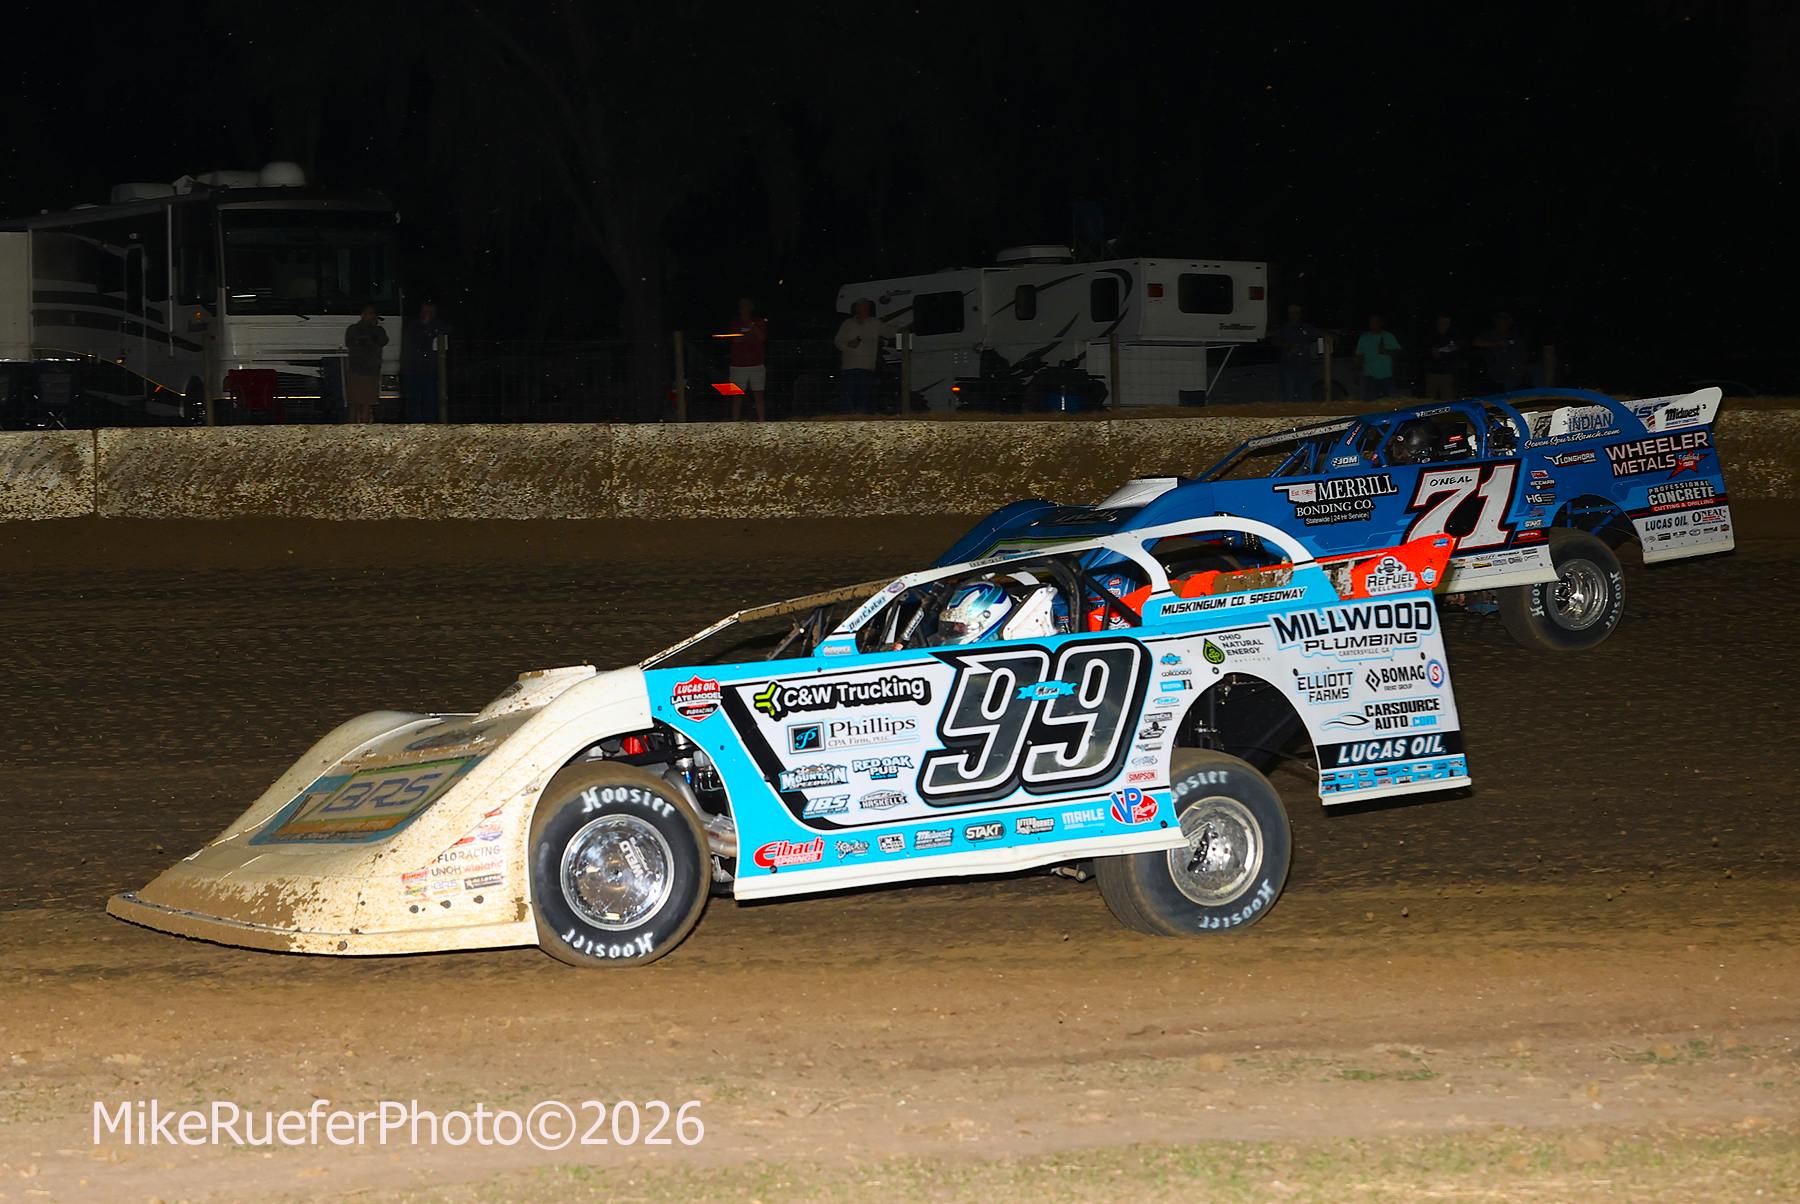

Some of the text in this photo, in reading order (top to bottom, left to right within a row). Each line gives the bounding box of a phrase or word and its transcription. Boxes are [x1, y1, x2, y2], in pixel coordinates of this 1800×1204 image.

[1568, 412, 1614, 431] INDIAN
[1665, 405, 1700, 421] Midwest
[1605, 432, 1708, 461] WHEELER
[1560, 452, 1595, 464] LONGHORN
[1613, 454, 1676, 476] METALS
[1318, 475, 1397, 501] MERRILL
[1429, 475, 1472, 487] O'NEAL
[1648, 480, 1709, 494] PROFESSIONAL
[1525, 493, 1543, 504] HG
[1648, 487, 1715, 506] CONCRETE
[1654, 503, 1680, 512] CUTTING
[1688, 499, 1714, 507] DRILLING
[1296, 499, 1374, 517] BONDING CO.
[1406, 464, 1516, 549] 71
[1645, 517, 1672, 531] LUCAS
[1675, 516, 1688, 527] OIL
[1370, 583, 1413, 593] WELLNESS
[1161, 588, 1306, 616] MUSKINGUM CO. SPEEDWAY
[1605, 571, 1623, 629] Hoosier
[1273, 601, 1432, 644] MILLWOOD
[1218, 633, 1241, 641] OHIO
[1222, 640, 1264, 649] NATURAL
[1304, 632, 1418, 651] PLUMBING
[1226, 647, 1261, 656] ENERGY
[1298, 671, 1354, 691] ELLIOTT
[1382, 665, 1426, 684] BOMAG
[677, 682, 716, 695] LUCAS OIL
[783, 678, 926, 708] C&W Trucking
[1308, 687, 1350, 702] FARMS
[671, 691, 723, 705] LATE MODEL
[1365, 698, 1441, 717] CARSOURCE
[829, 717, 916, 738] Phillips
[919, 639, 1148, 803] 99
[828, 739, 846, 748] CPA
[1337, 735, 1445, 765] LUCAS OIL
[852, 755, 914, 773] RED OAK
[869, 766, 899, 776] PUB
[781, 766, 848, 791] MOUNTAIN
[1128, 771, 1156, 781] SIMPSON
[581, 786, 675, 818] Hoosier
[1110, 787, 1142, 824] VP
[1062, 808, 1105, 824] MAHLE
[916, 829, 953, 840] Midwest
[966, 823, 1001, 839] STAKT
[437, 845, 501, 863] FLORACING
[754, 837, 824, 867] Eibach
[774, 852, 820, 866] SPRINGS
[1198, 878, 1276, 929] Hoosier
[562, 928, 653, 959] Hoosier
